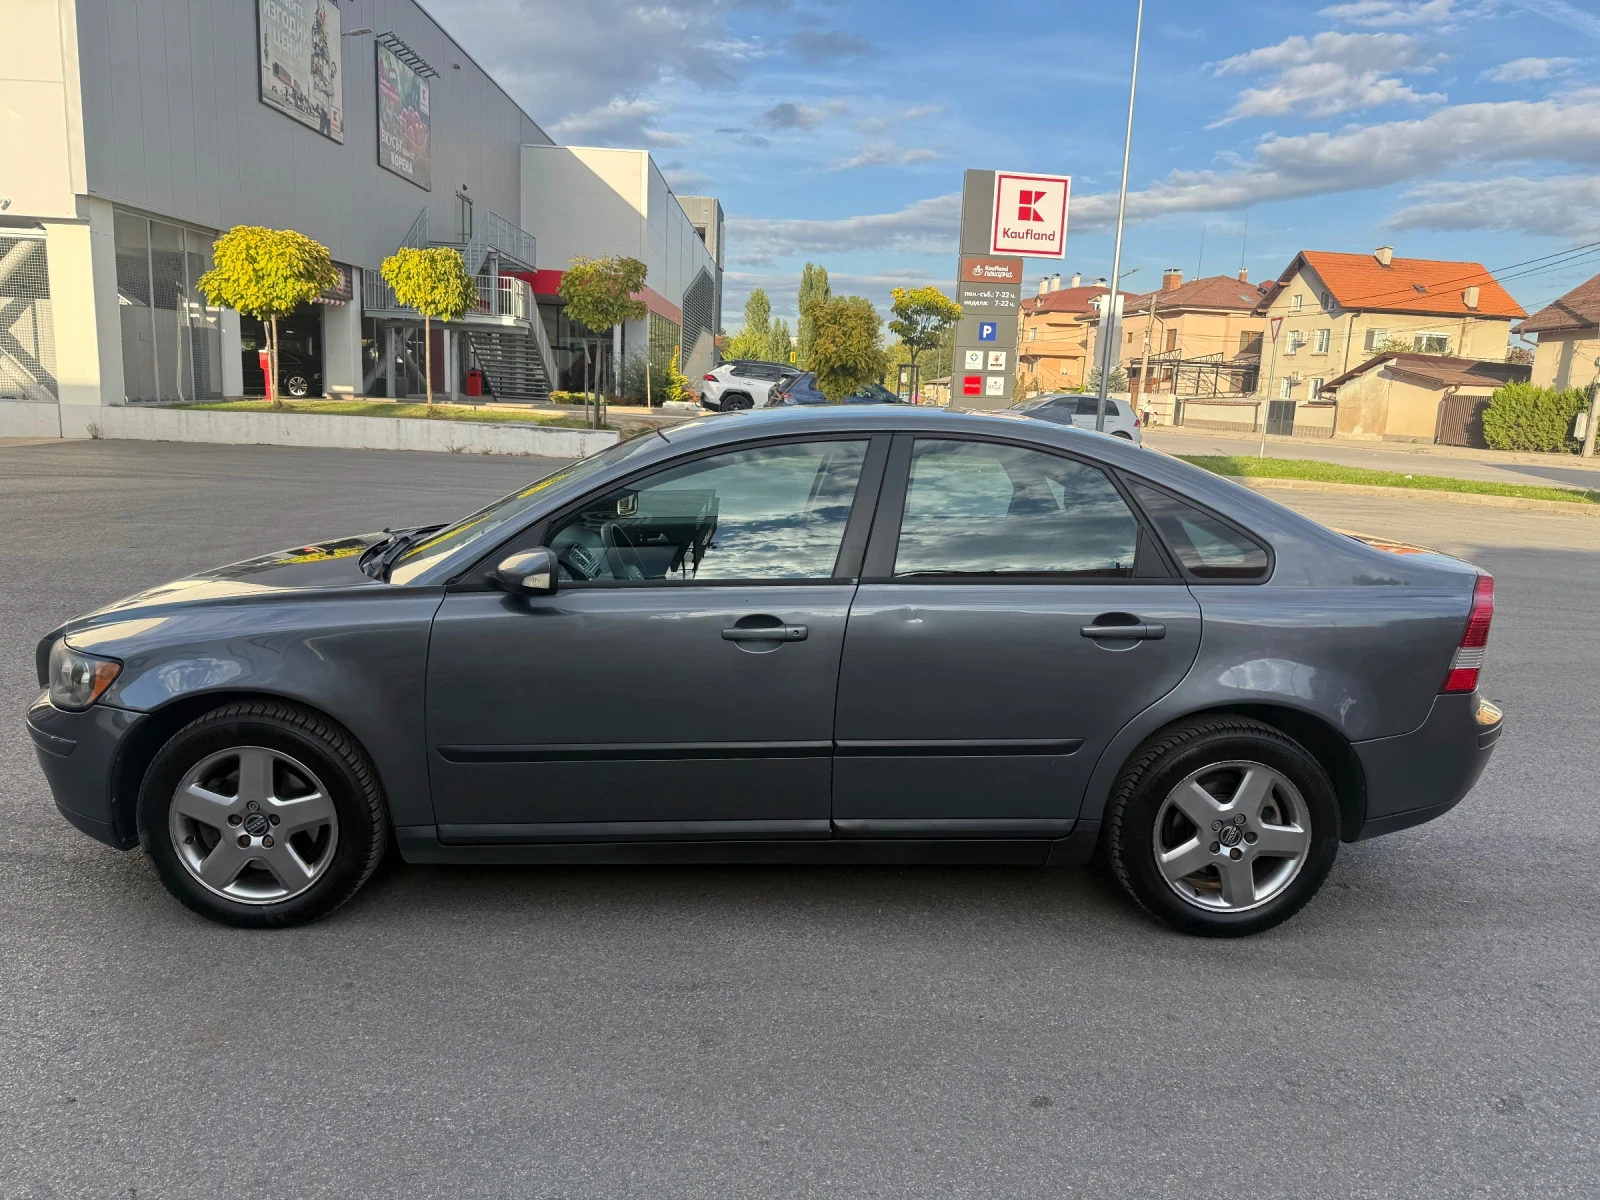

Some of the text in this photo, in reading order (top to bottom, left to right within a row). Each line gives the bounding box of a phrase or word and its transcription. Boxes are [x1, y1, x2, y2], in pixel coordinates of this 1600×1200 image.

[262, 0, 310, 44] ИЗГОДНИ
[273, 26, 302, 60] ЦЕНИ!
[382, 129, 402, 153] ВКУСЪТ
[391, 151, 413, 175] КОРЕНА
[1003, 227, 1056, 241] Kaufland
[983, 325, 992, 338] P
